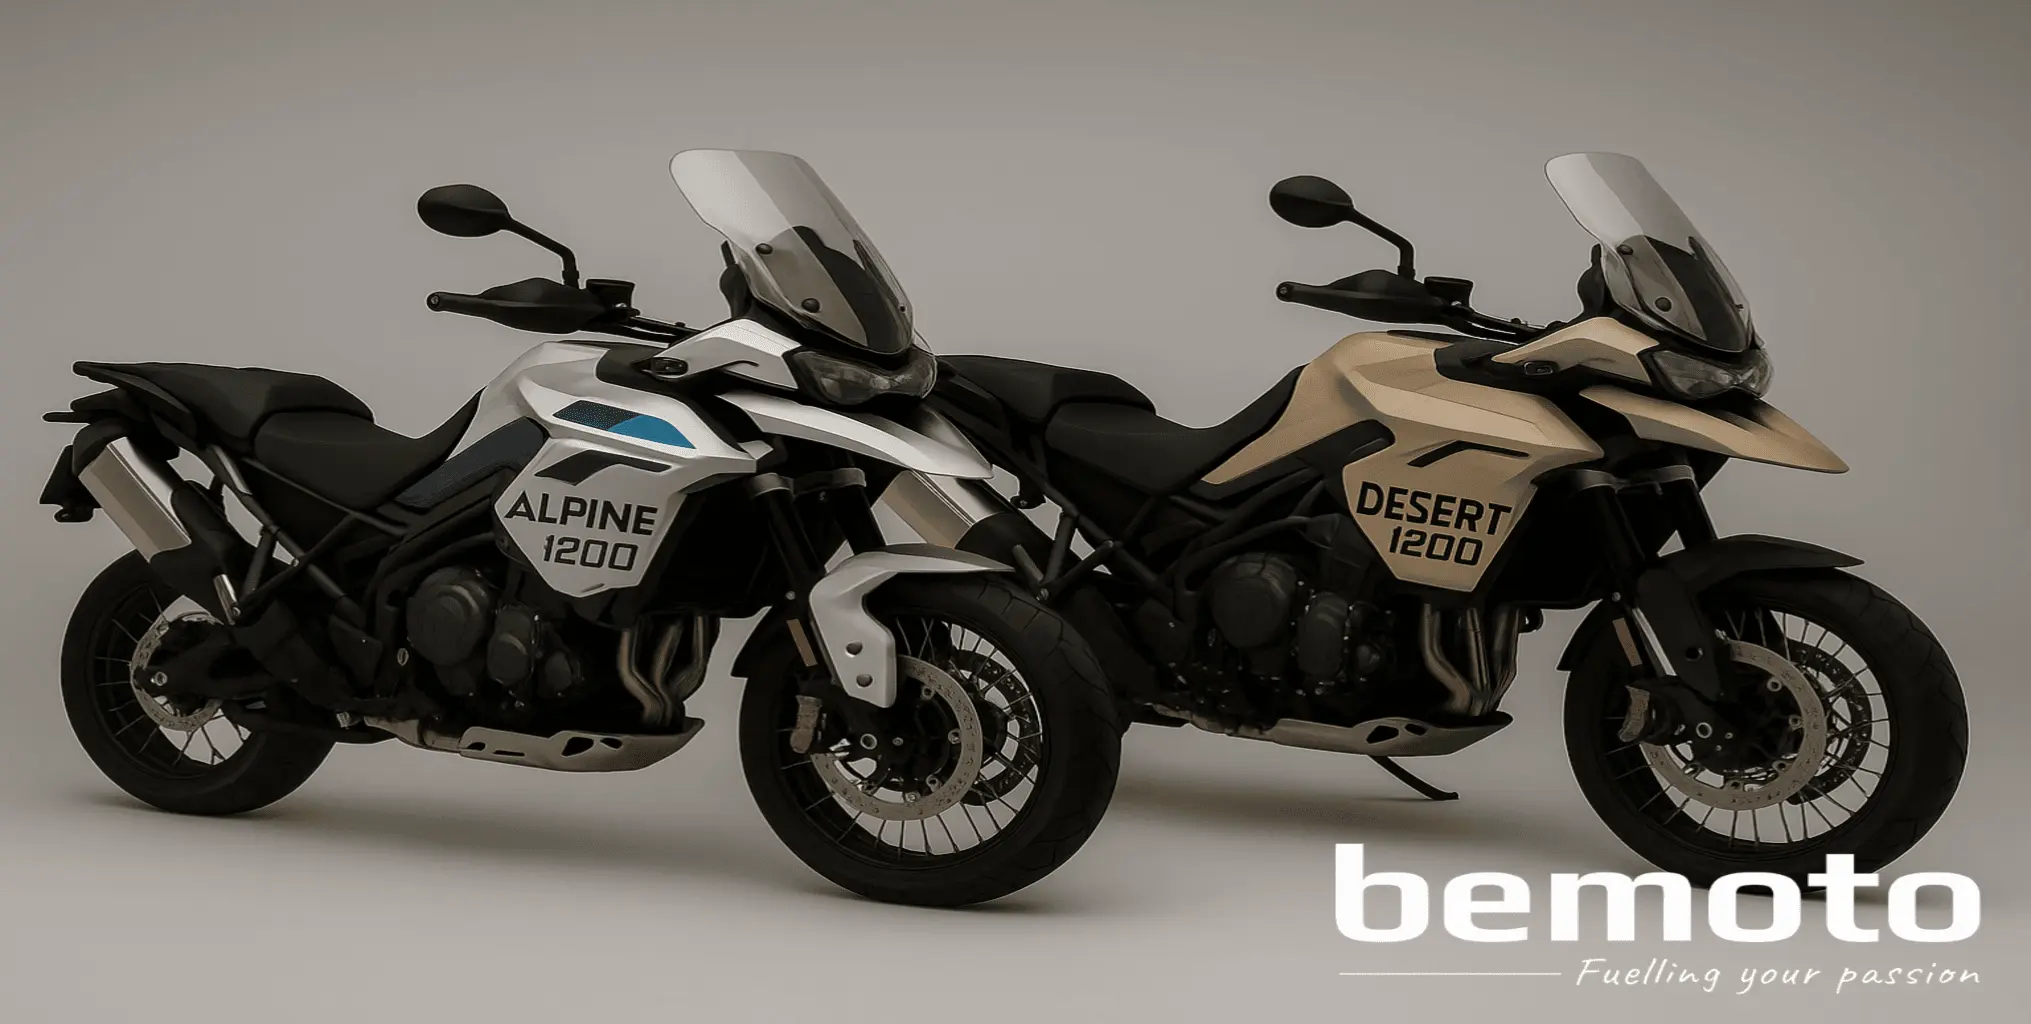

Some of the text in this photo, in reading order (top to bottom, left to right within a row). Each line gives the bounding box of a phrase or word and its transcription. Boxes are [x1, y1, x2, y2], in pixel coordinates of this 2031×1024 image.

[504, 489, 658, 536] ALPINE
[1356, 480, 1513, 536] DESERT
[543, 534, 639, 572] 1200
[1389, 525, 1483, 566] 1200
